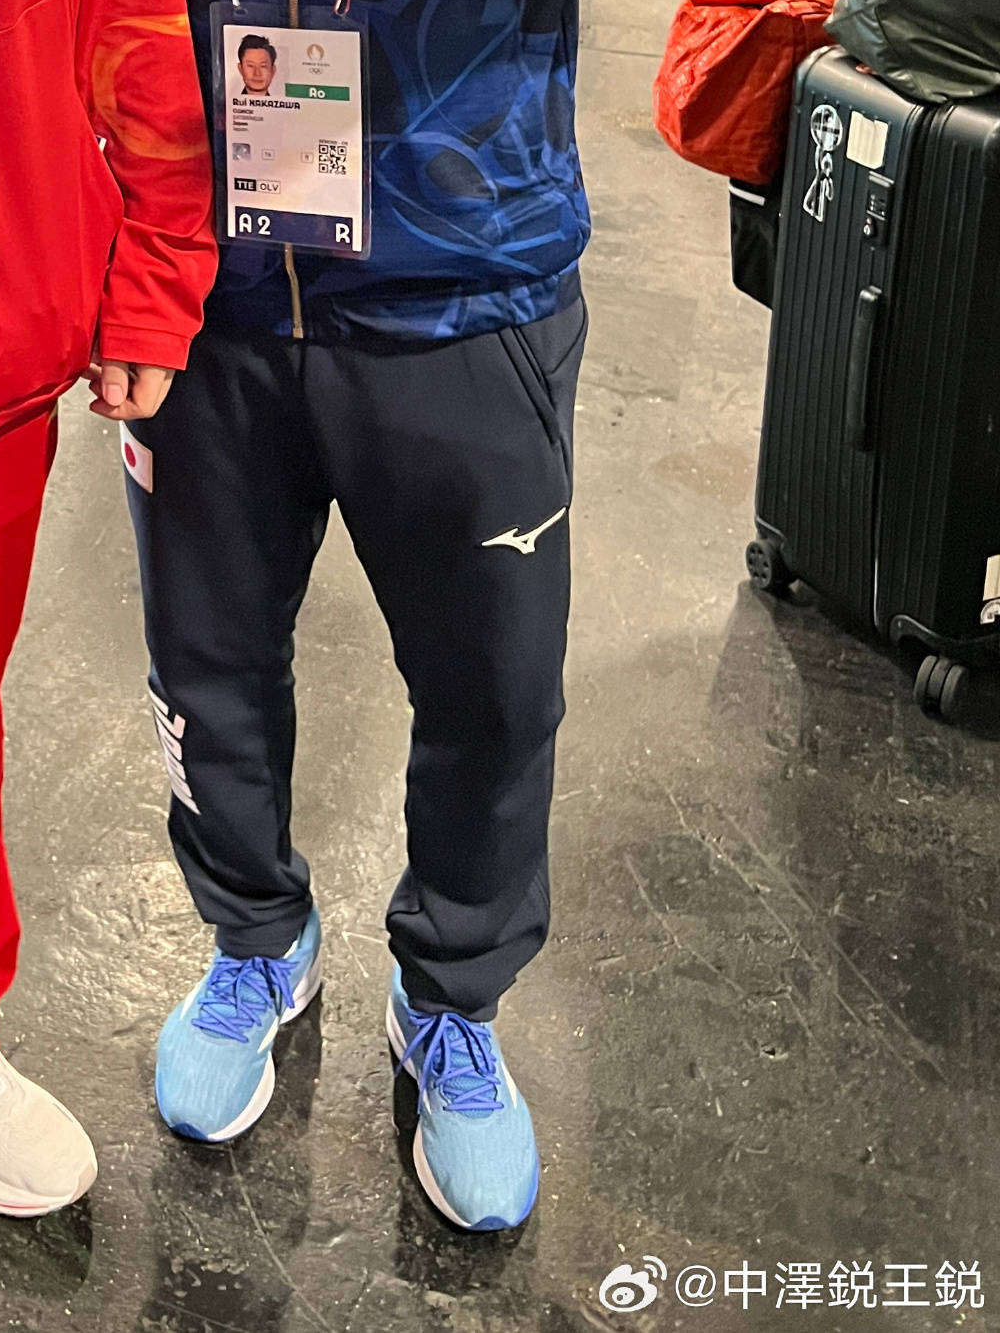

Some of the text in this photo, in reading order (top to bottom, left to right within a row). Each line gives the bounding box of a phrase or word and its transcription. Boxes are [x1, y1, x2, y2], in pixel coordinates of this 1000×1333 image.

[236, 180, 255, 190] TTE
[259, 182, 279, 192] OLV
[239, 213, 351, 244] A 2 R
